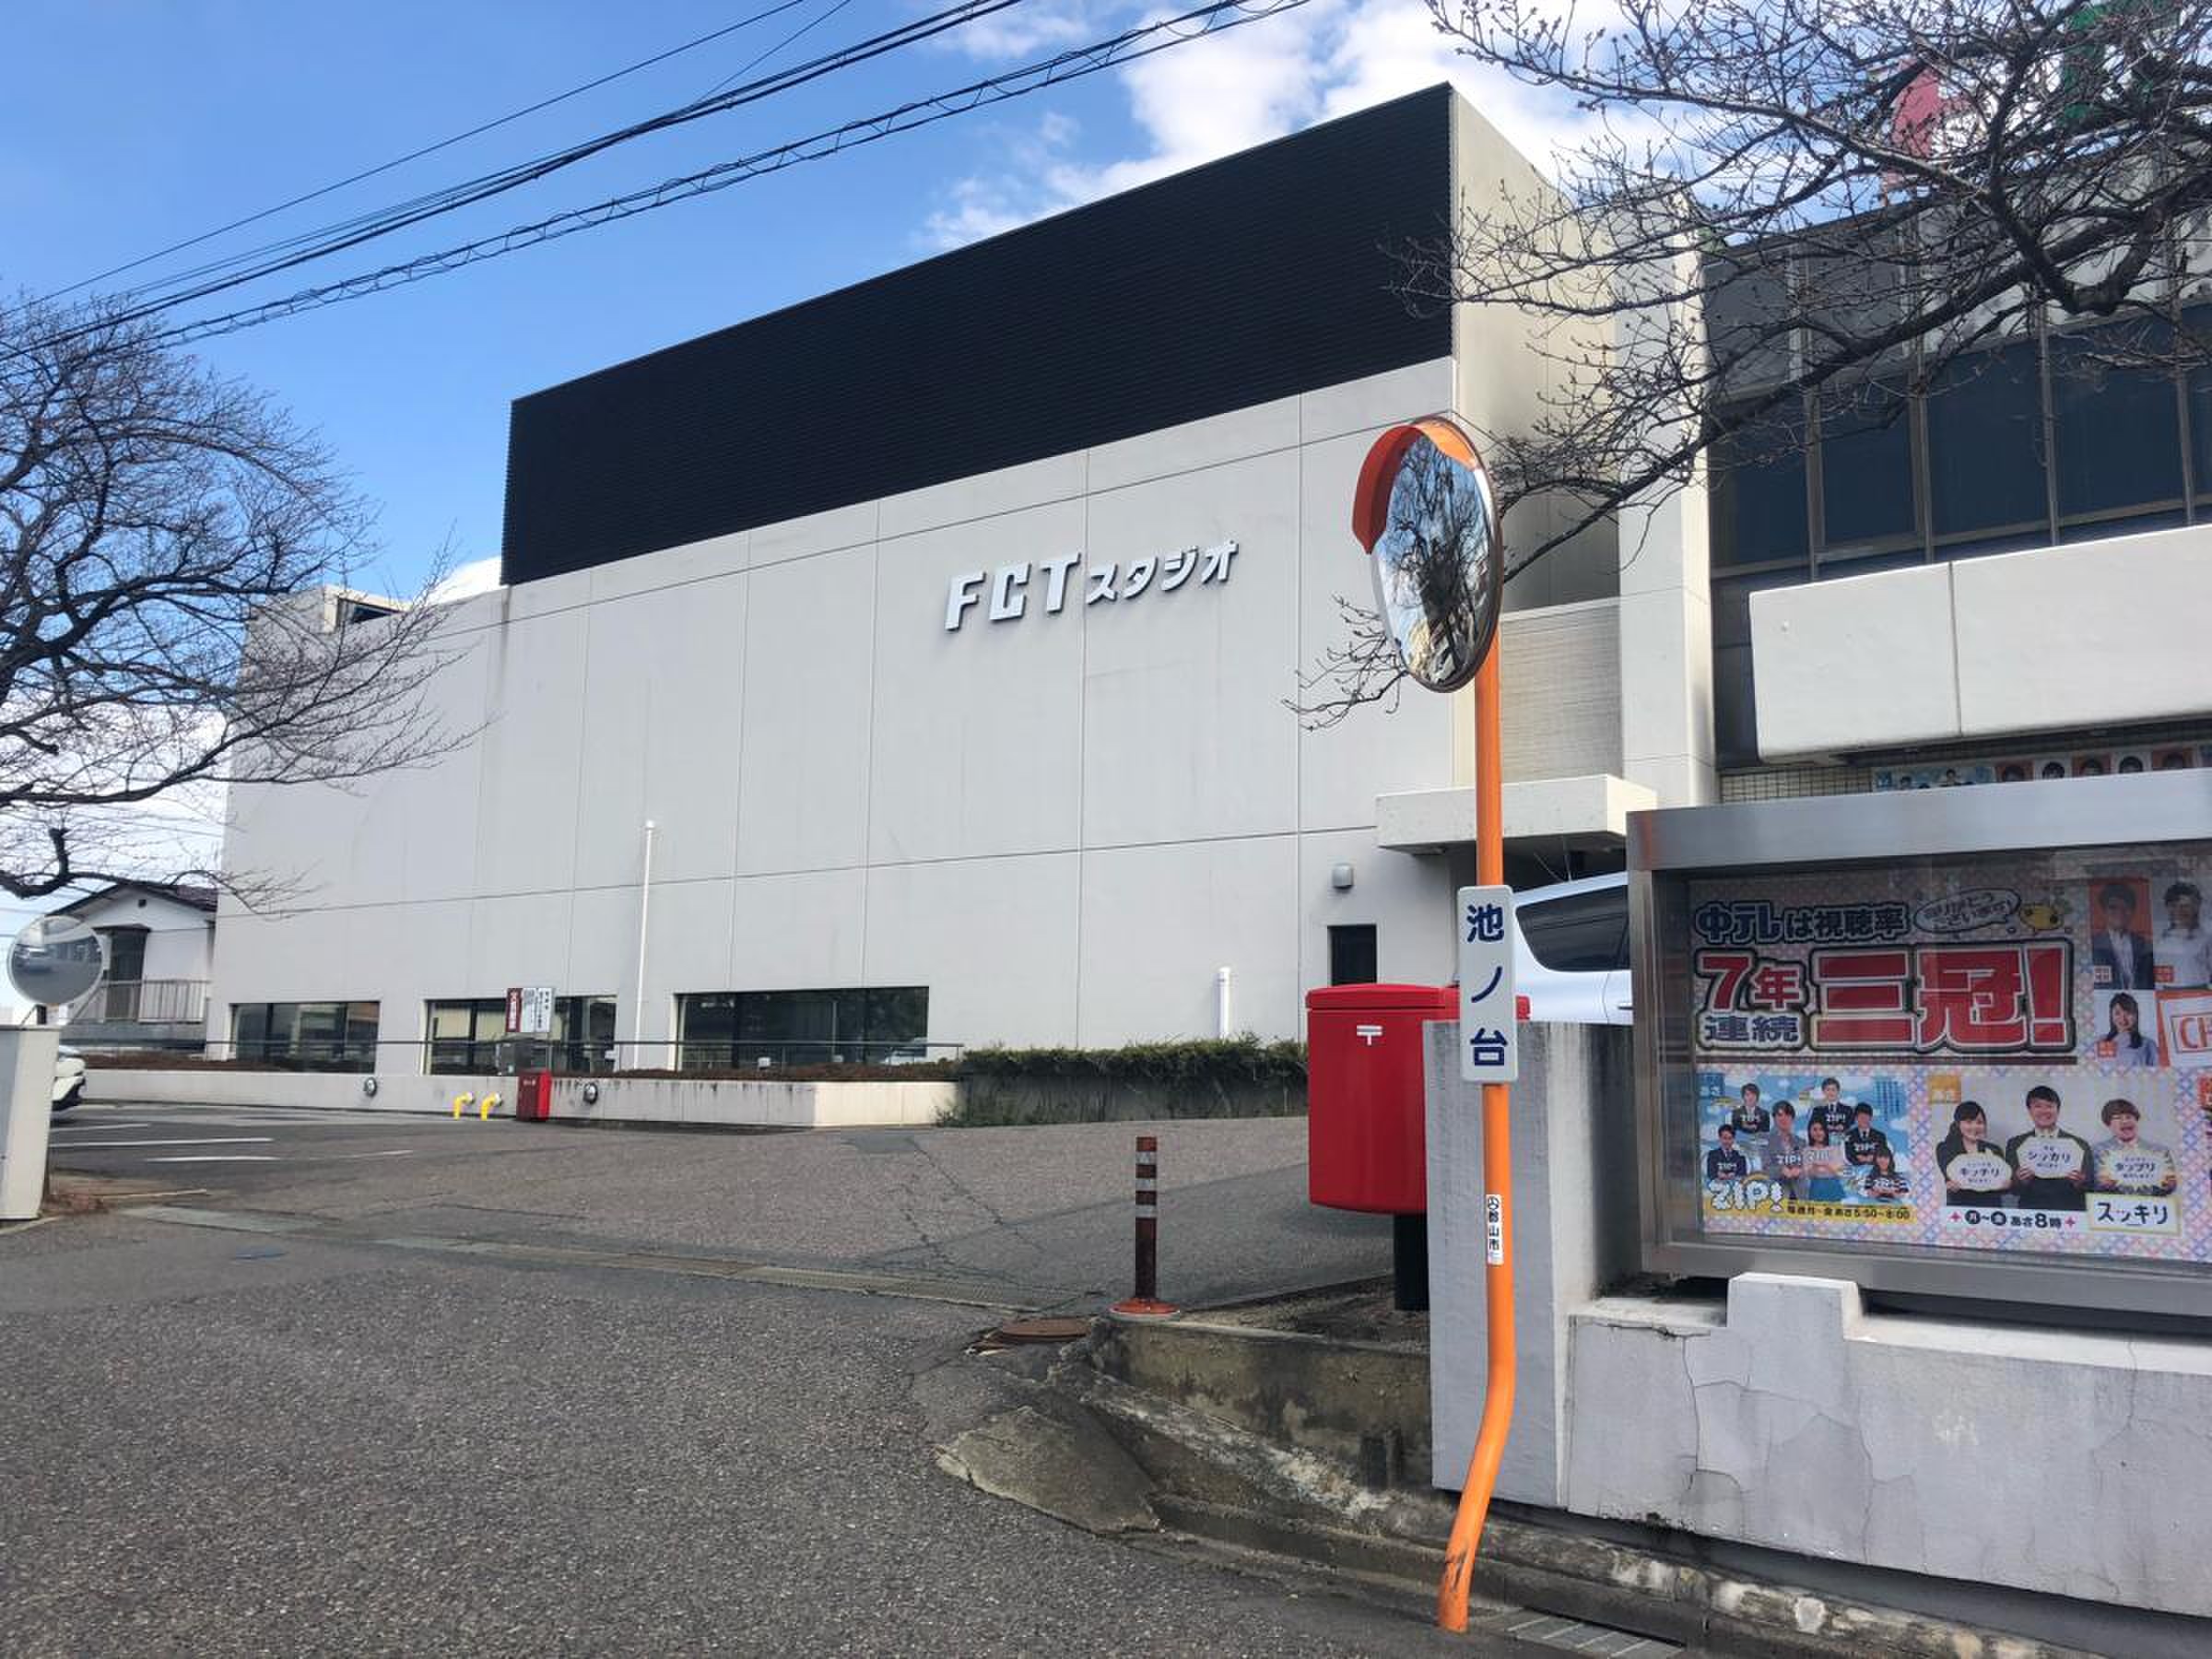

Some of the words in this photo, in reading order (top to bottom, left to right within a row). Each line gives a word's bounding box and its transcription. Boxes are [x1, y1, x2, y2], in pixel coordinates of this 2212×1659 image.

[1696, 900, 1907, 944] 中テレは視聴率
[1466, 903, 1508, 1066] 池ノ台
[1701, 954, 1801, 1011] 7年
[1705, 1015, 1800, 1043] 連続
[1708, 1178, 1784, 1213] ZIP!
[2097, 1201, 2168, 1225] スッキリ
